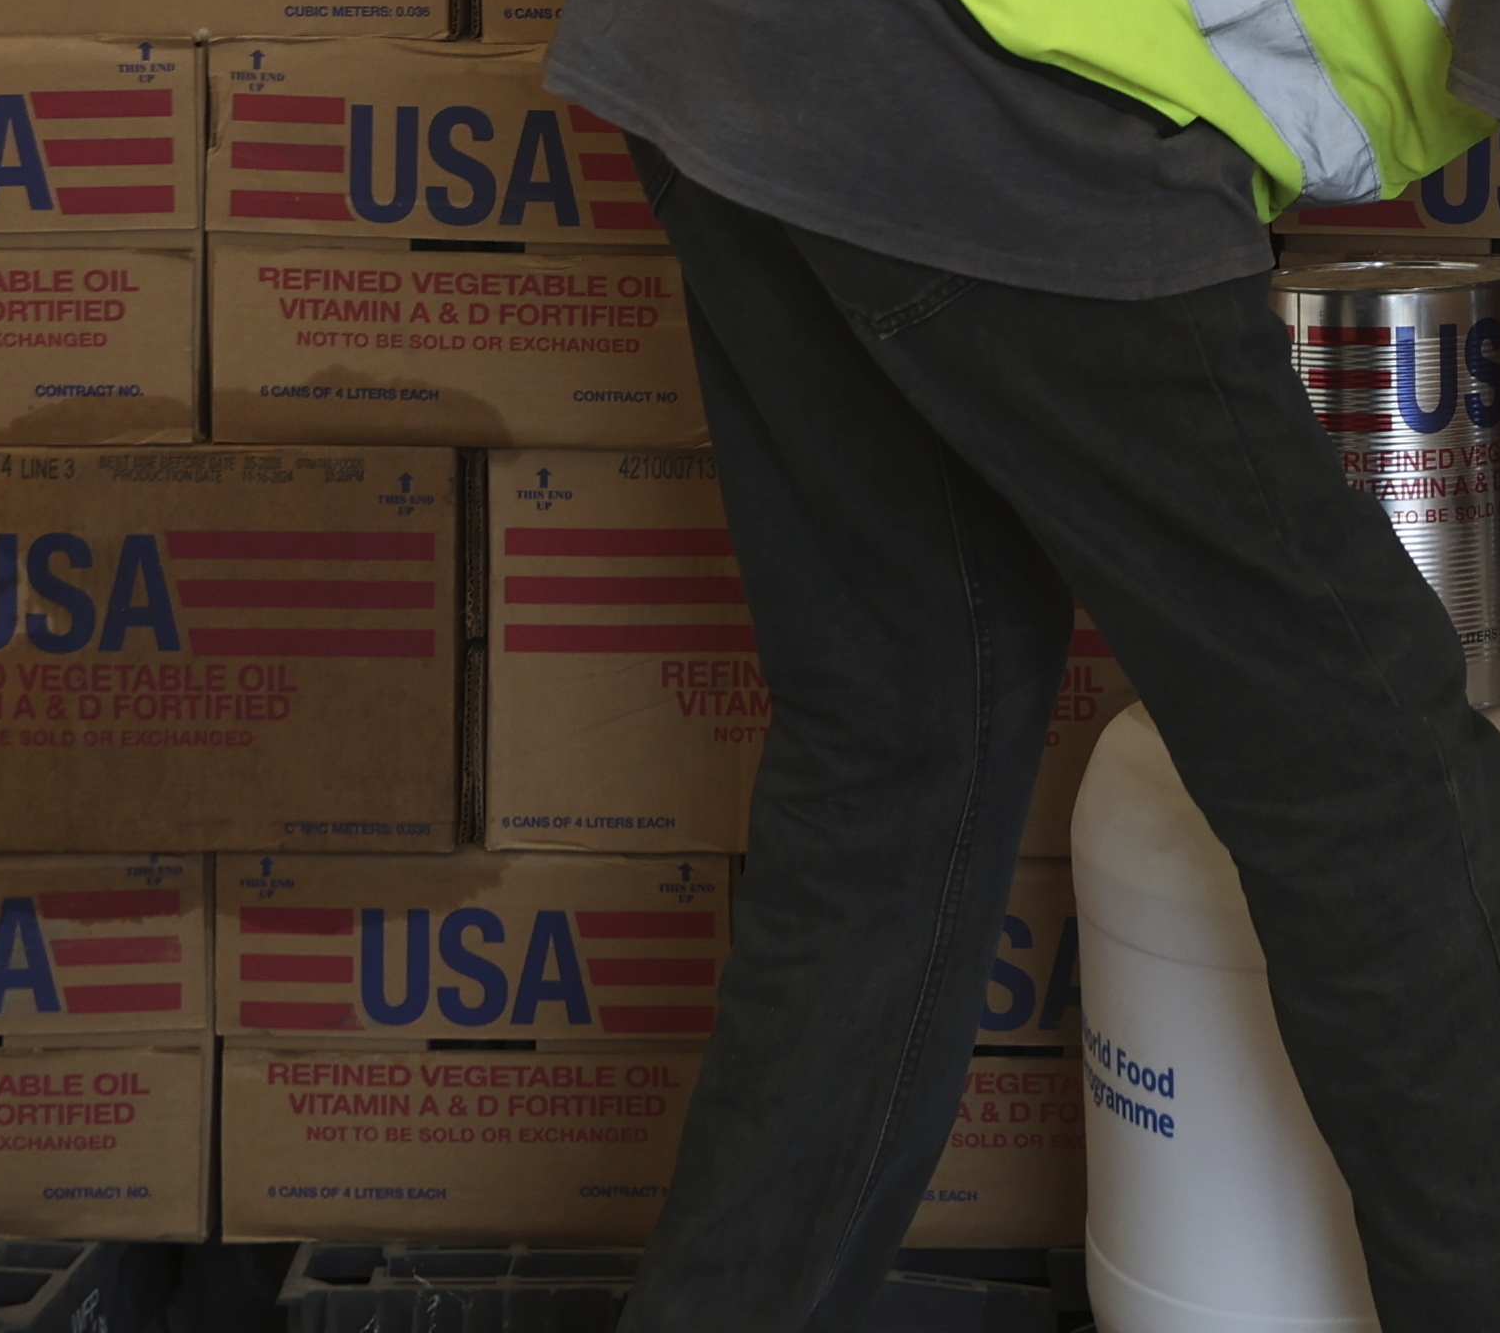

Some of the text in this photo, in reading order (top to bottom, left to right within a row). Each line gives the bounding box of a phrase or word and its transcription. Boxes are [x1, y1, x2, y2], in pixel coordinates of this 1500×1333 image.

[285, 5, 431, 18] CUBIC METERS: 0.036
[1343, 447, 1455, 473] REFINED
[1453, 476, 1470, 496] A
[1474, 473, 1489, 493] &
[1393, 502, 1495, 525] TO BE SOLD
[1459, 628, 1497, 645] LITERS
[360, 907, 593, 1028] USA
[1116, 1046, 1175, 1099] Food
